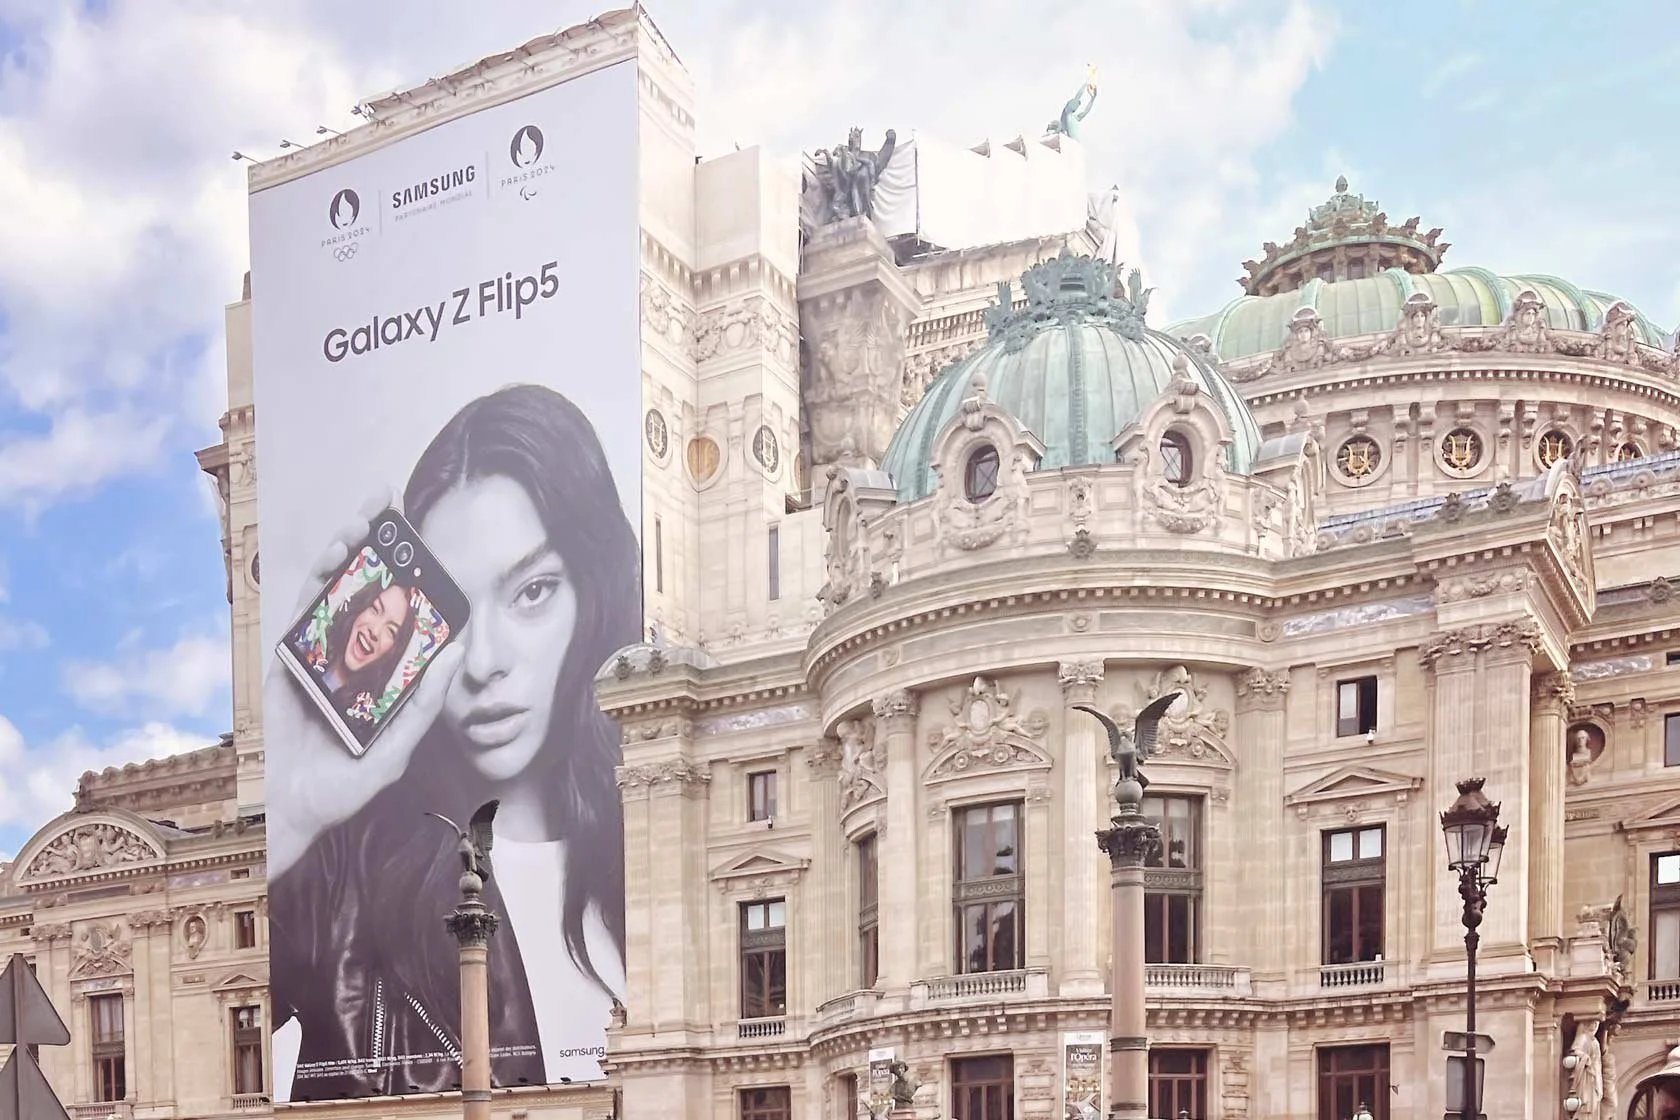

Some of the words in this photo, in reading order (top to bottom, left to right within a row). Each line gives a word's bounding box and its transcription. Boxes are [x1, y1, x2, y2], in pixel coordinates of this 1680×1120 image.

[392, 165, 475, 208] SAMSUNG
[501, 173, 528, 187] PARIS
[530, 164, 555, 179] 2024
[321, 234, 346, 247] PARIS
[348, 226, 370, 240] 2024
[323, 302, 446, 362] Galaxy
[452, 287, 471, 325] Z
[479, 261, 559, 319] Flip5
[559, 1046, 605, 1058] samsung
